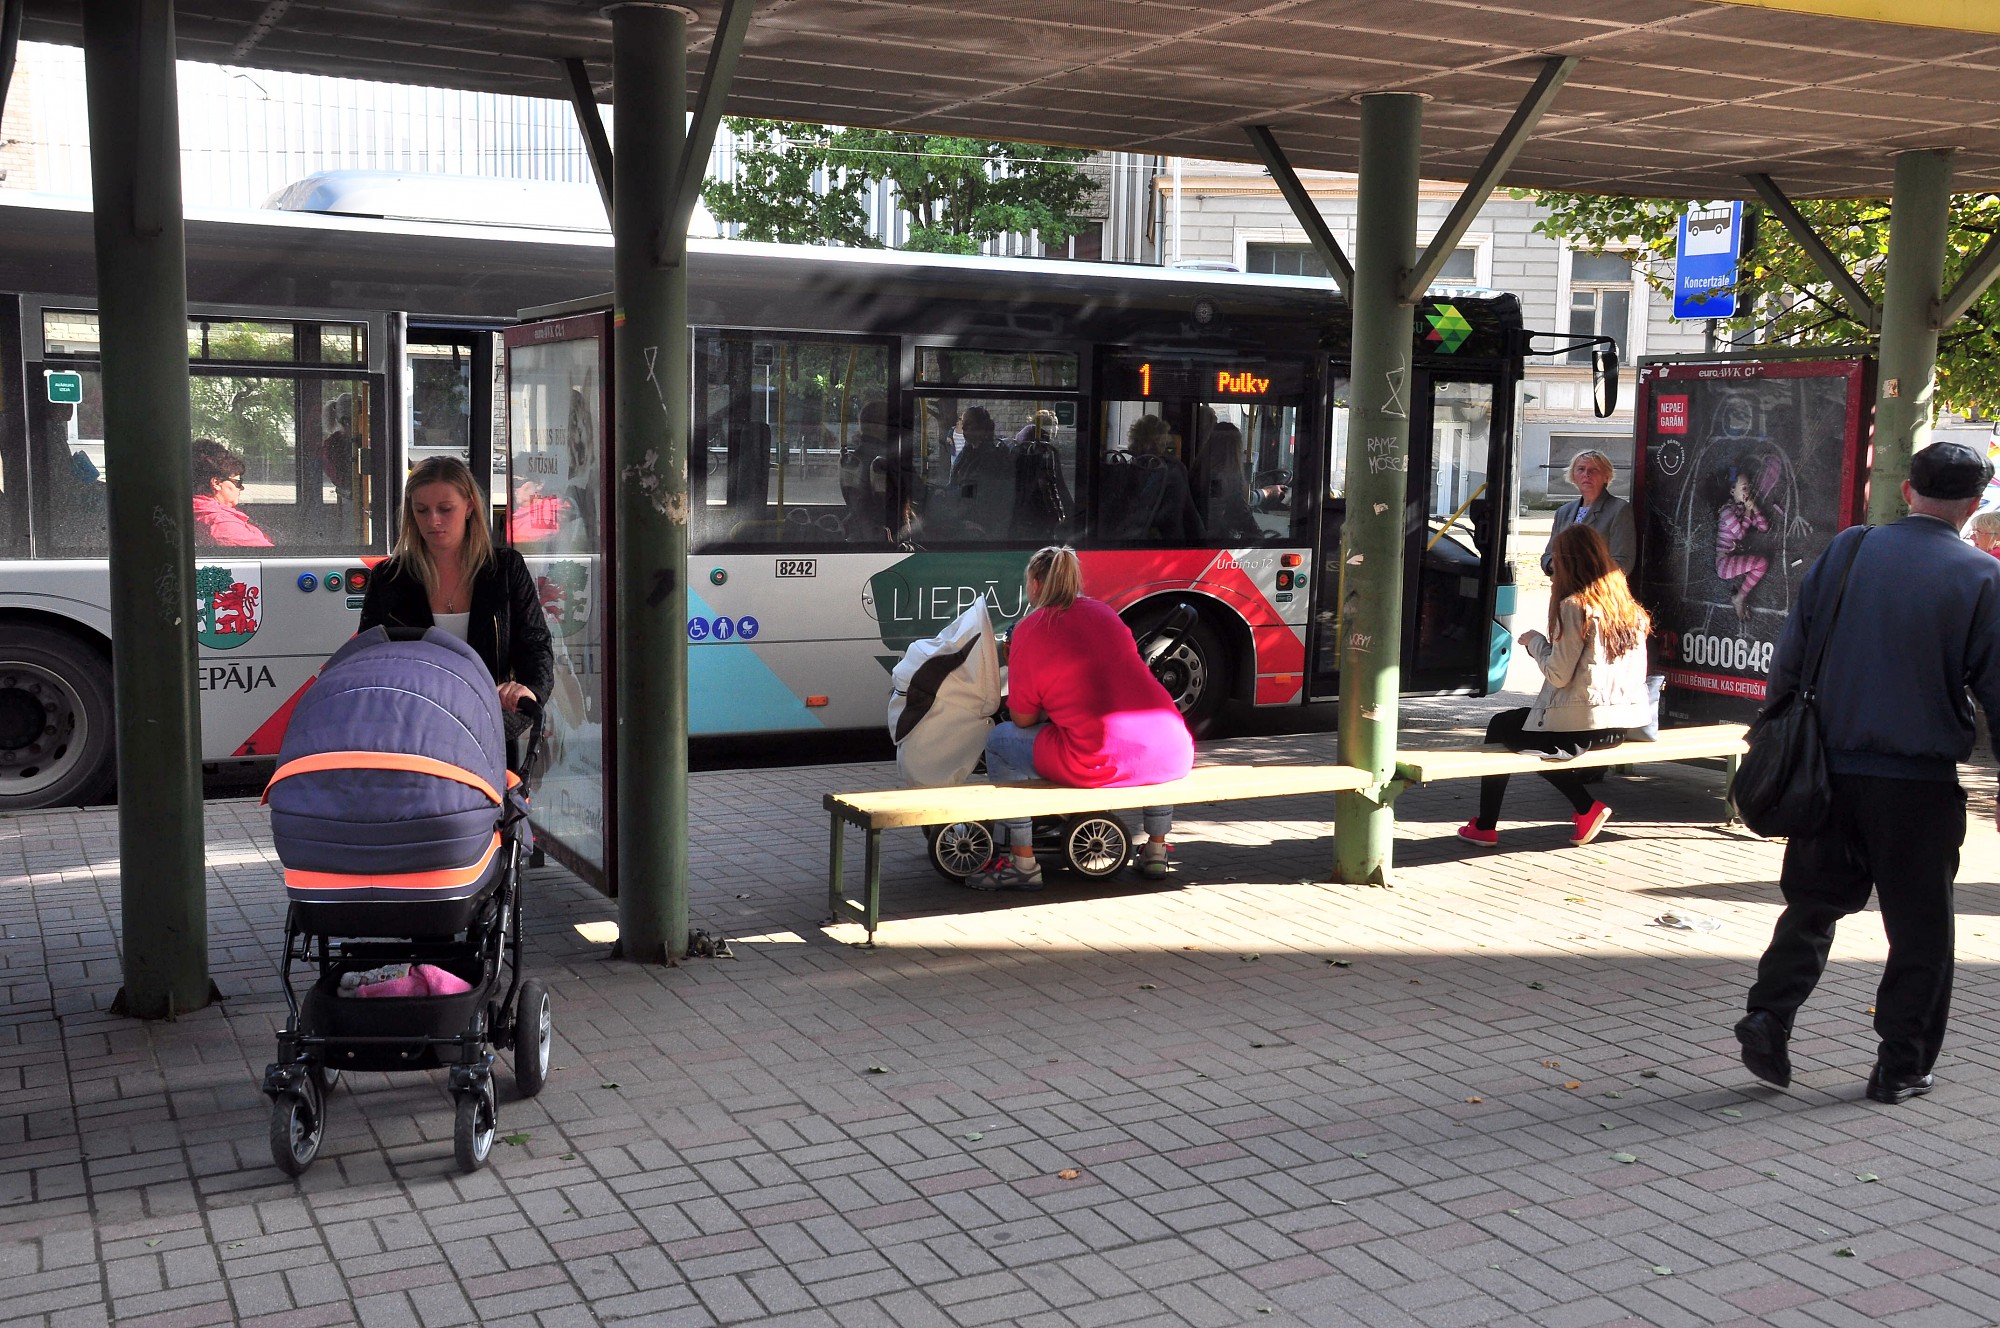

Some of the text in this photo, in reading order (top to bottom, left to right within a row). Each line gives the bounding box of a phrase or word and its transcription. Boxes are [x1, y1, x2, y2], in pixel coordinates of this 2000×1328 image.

[1684, 274, 1730, 288] Koncertzāle
[1139, 363, 1270, 396] 1 Pulkv
[1698, 367, 1741, 378] euroAWK
[1660, 402, 1684, 413] NEPAEJ
[1660, 414, 1684, 427] GARĀM
[779, 561, 813, 576] 8242
[1217, 558, 1259, 570] Urbino
[893, 580, 1034, 621] LIEPĀJ
[1683, 632, 1774, 673] 9000648
[199, 662, 276, 693] EPĀJA
[1674, 673, 1689, 685] LATU
[1689, 674, 1720, 690] BĒRNIEM,
[1720, 680, 1734, 692] KAS
[1735, 681, 1760, 695] CIETUŠI
